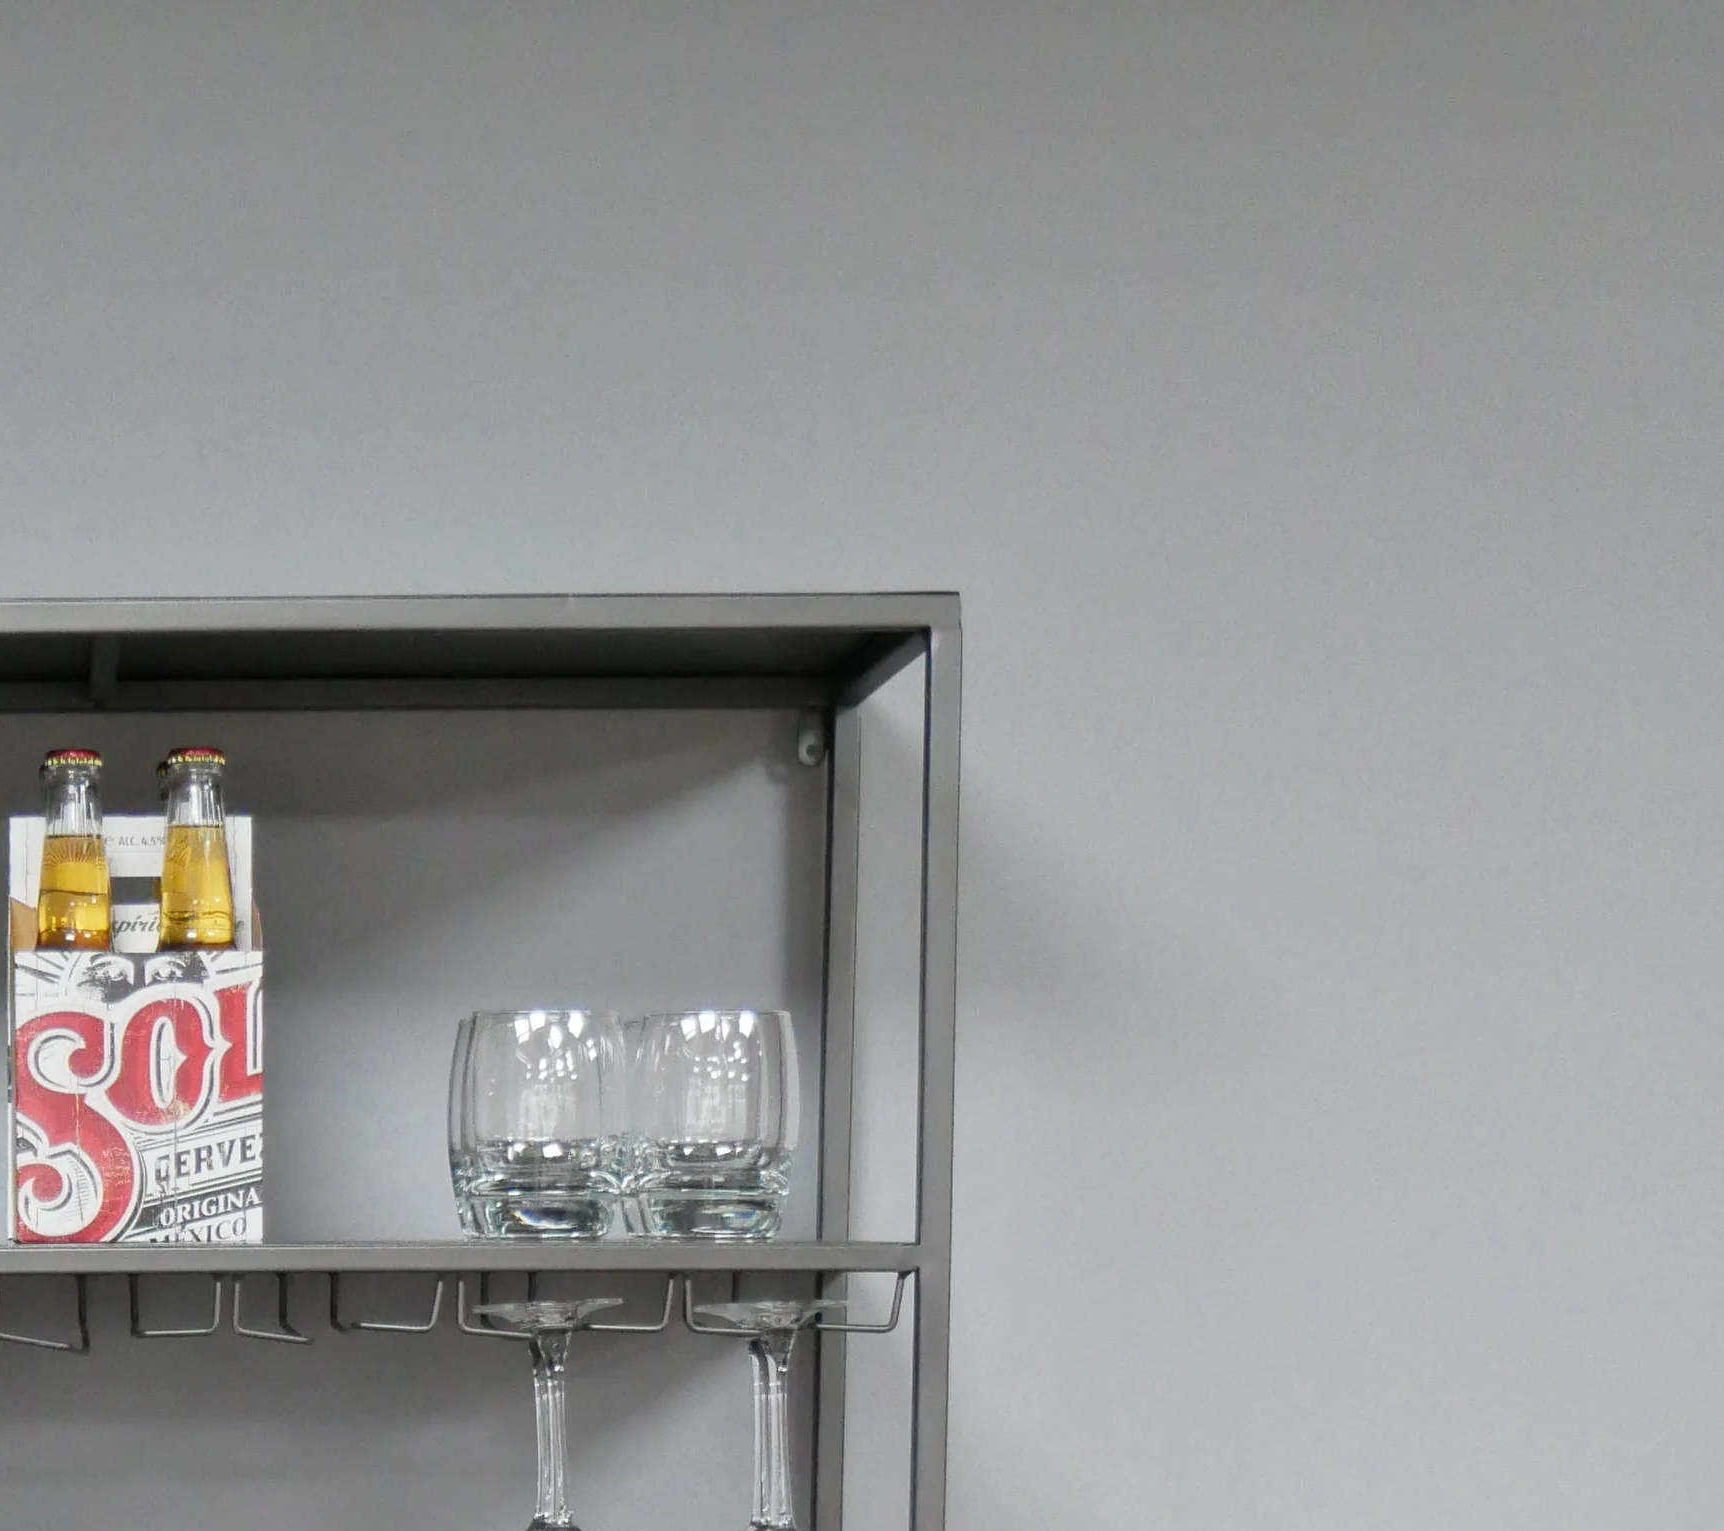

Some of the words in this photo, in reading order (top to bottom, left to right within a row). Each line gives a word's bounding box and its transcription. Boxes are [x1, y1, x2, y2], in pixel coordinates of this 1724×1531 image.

[16, 984, 263, 1244] SOL
[155, 1132, 263, 1180] CERVE
[158, 1187, 263, 1227] ORIGINA
